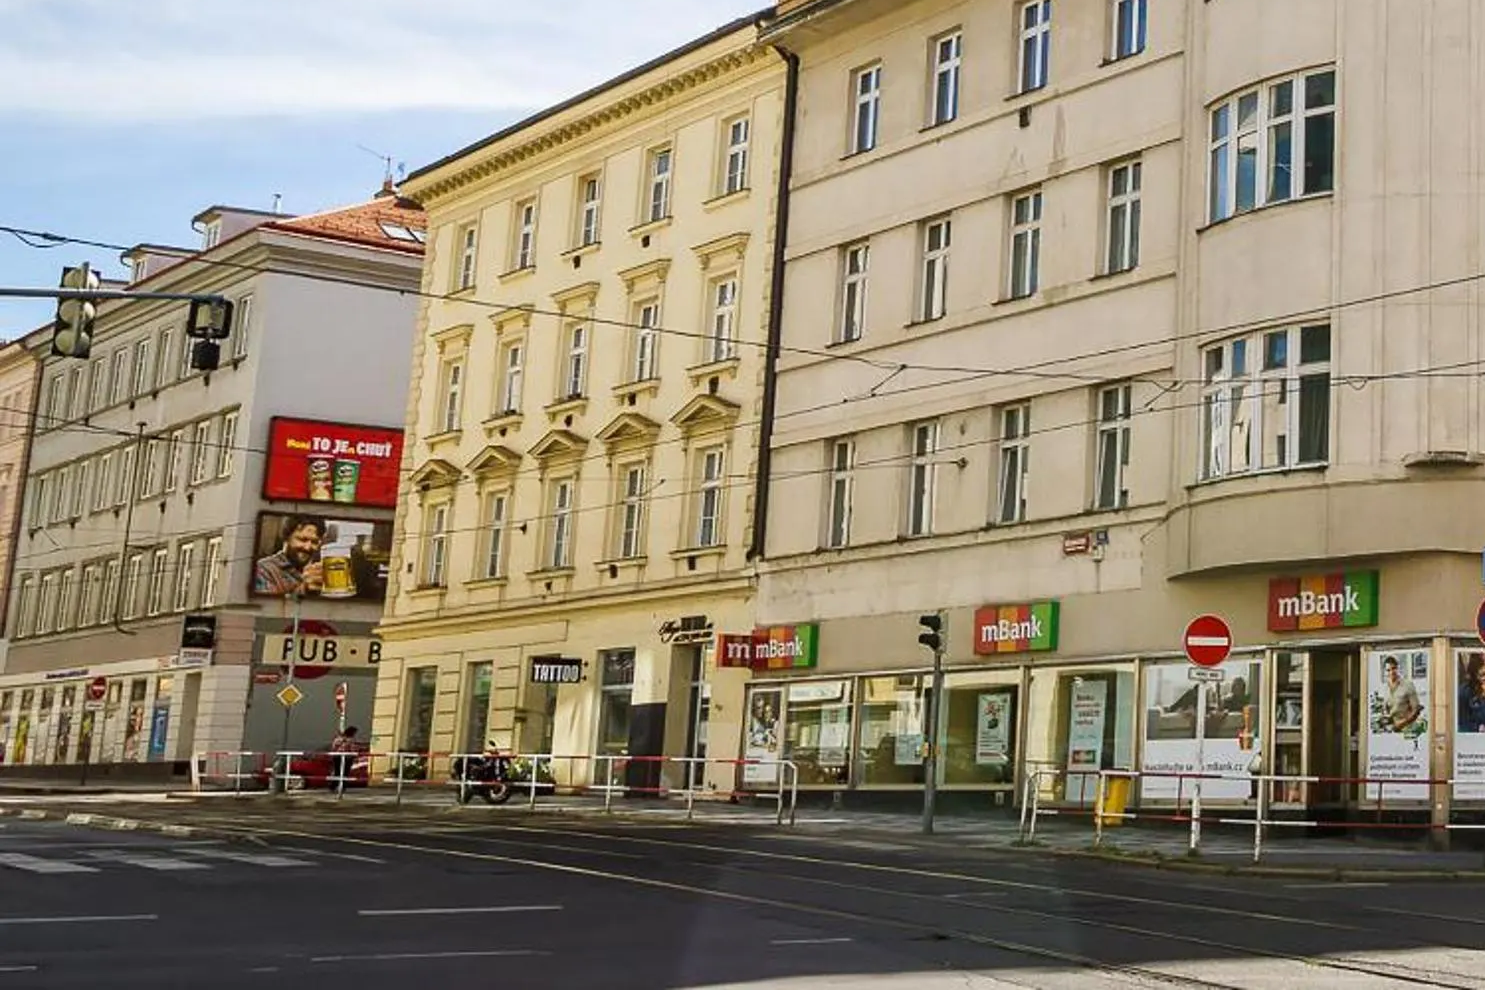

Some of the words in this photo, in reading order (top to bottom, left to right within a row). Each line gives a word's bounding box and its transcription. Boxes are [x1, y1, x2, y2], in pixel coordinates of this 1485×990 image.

[312, 437, 331, 451] TO
[1278, 585, 1360, 618] mBank
[981, 614, 1042, 643] mBank
[282, 638, 338, 662] PUB
[727, 641, 750, 659] m
[755, 640, 803, 659] mBank
[533, 663, 580, 682] TATTOO
